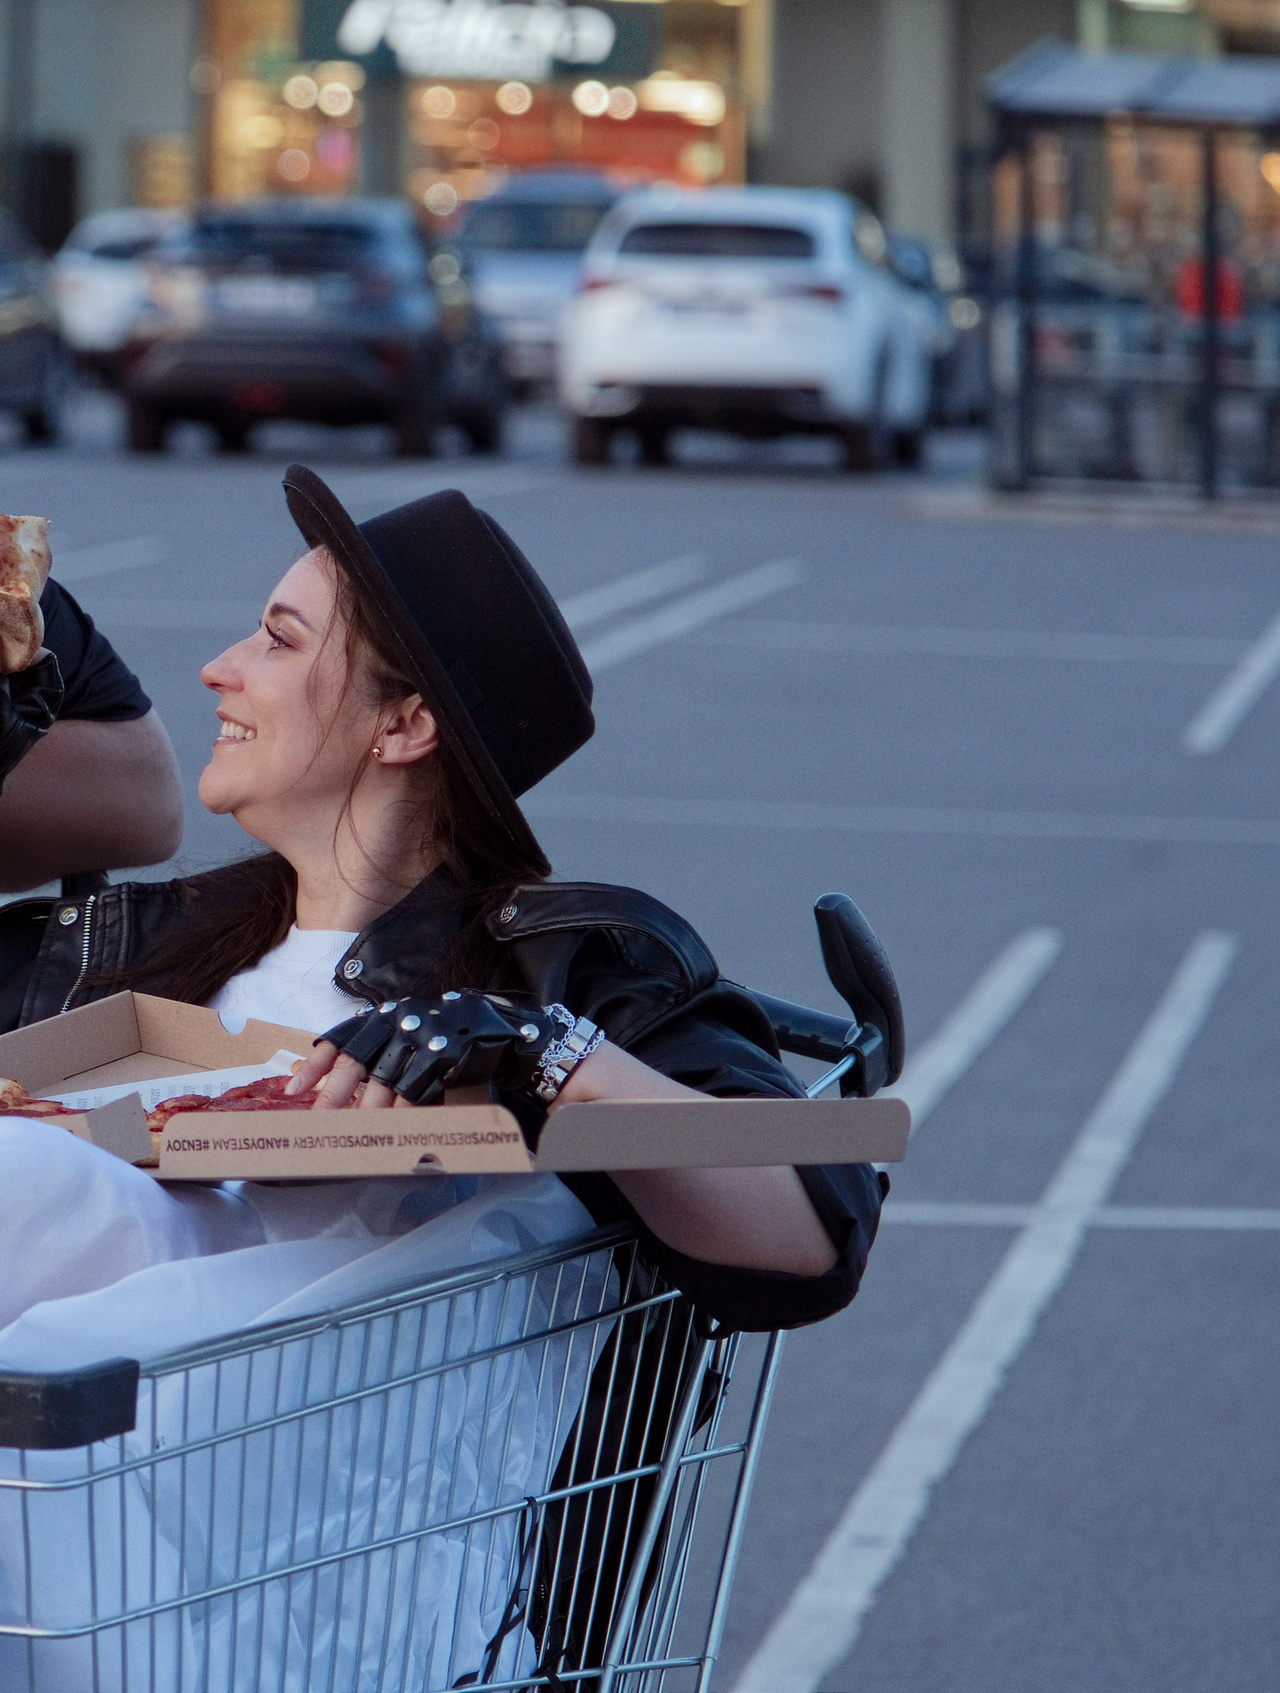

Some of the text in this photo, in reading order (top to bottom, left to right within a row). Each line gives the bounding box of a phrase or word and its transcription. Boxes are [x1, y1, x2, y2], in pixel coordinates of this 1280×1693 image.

[166, 1131, 519, 1152] #ANDYSRESTAURANT #ANDYSDELIVERY #ANDYSTEAM #ENJOY
